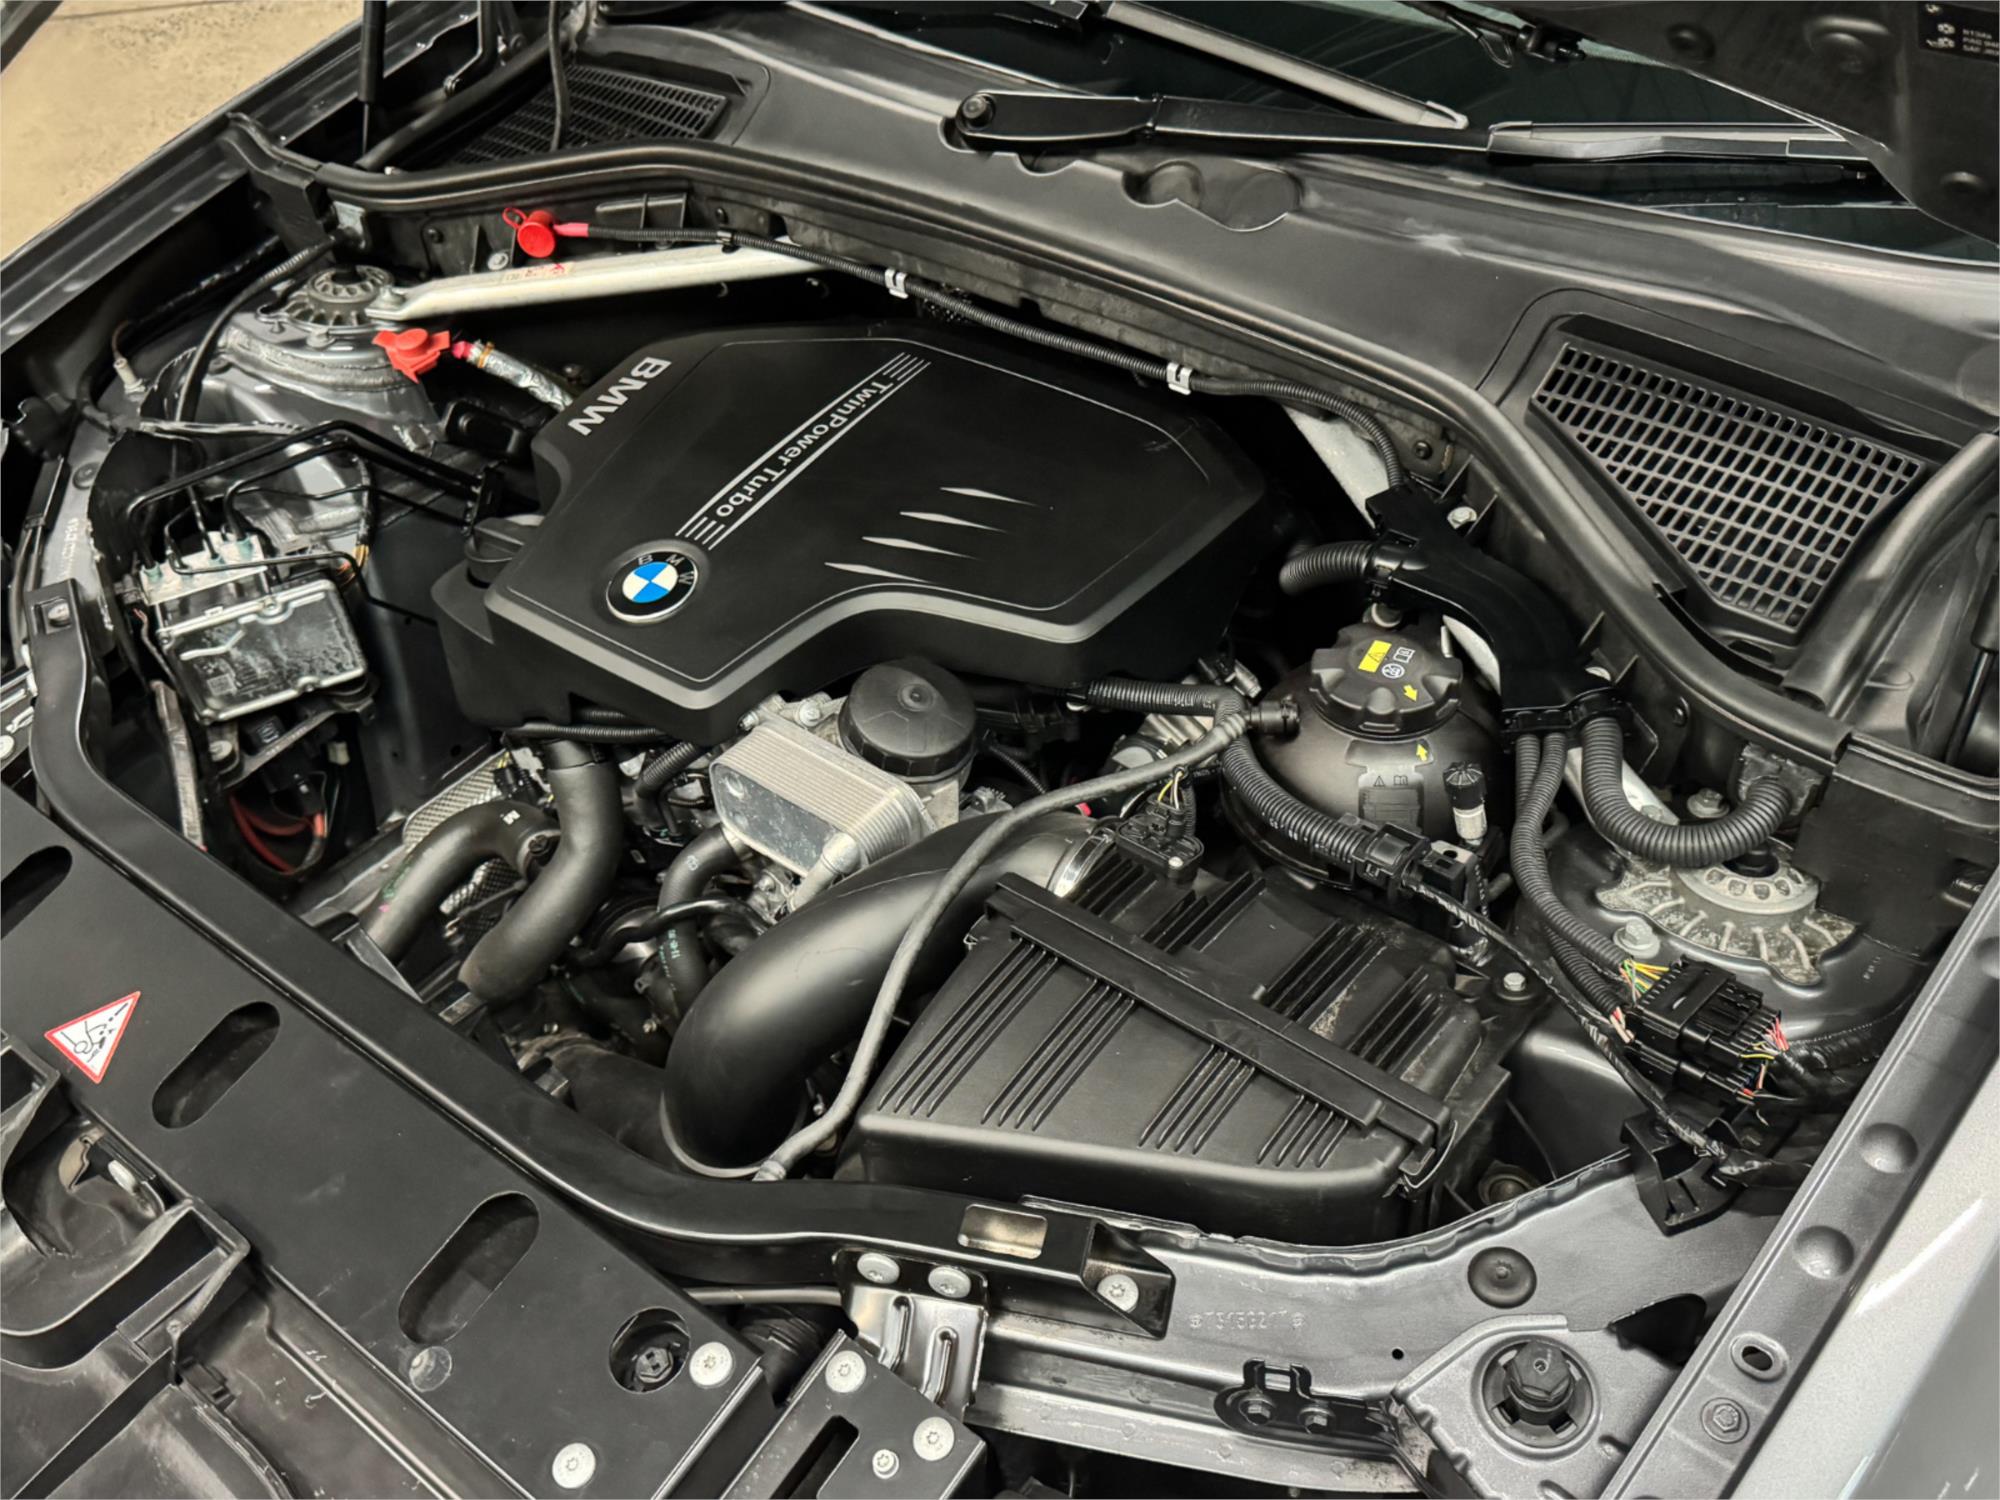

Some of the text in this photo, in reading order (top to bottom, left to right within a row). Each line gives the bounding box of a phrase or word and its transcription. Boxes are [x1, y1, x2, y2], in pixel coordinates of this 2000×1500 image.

[567, 356, 672, 436] BMW
[715, 380, 894, 518] TwinPower Turbo
[638, 553, 696, 586] BMW
